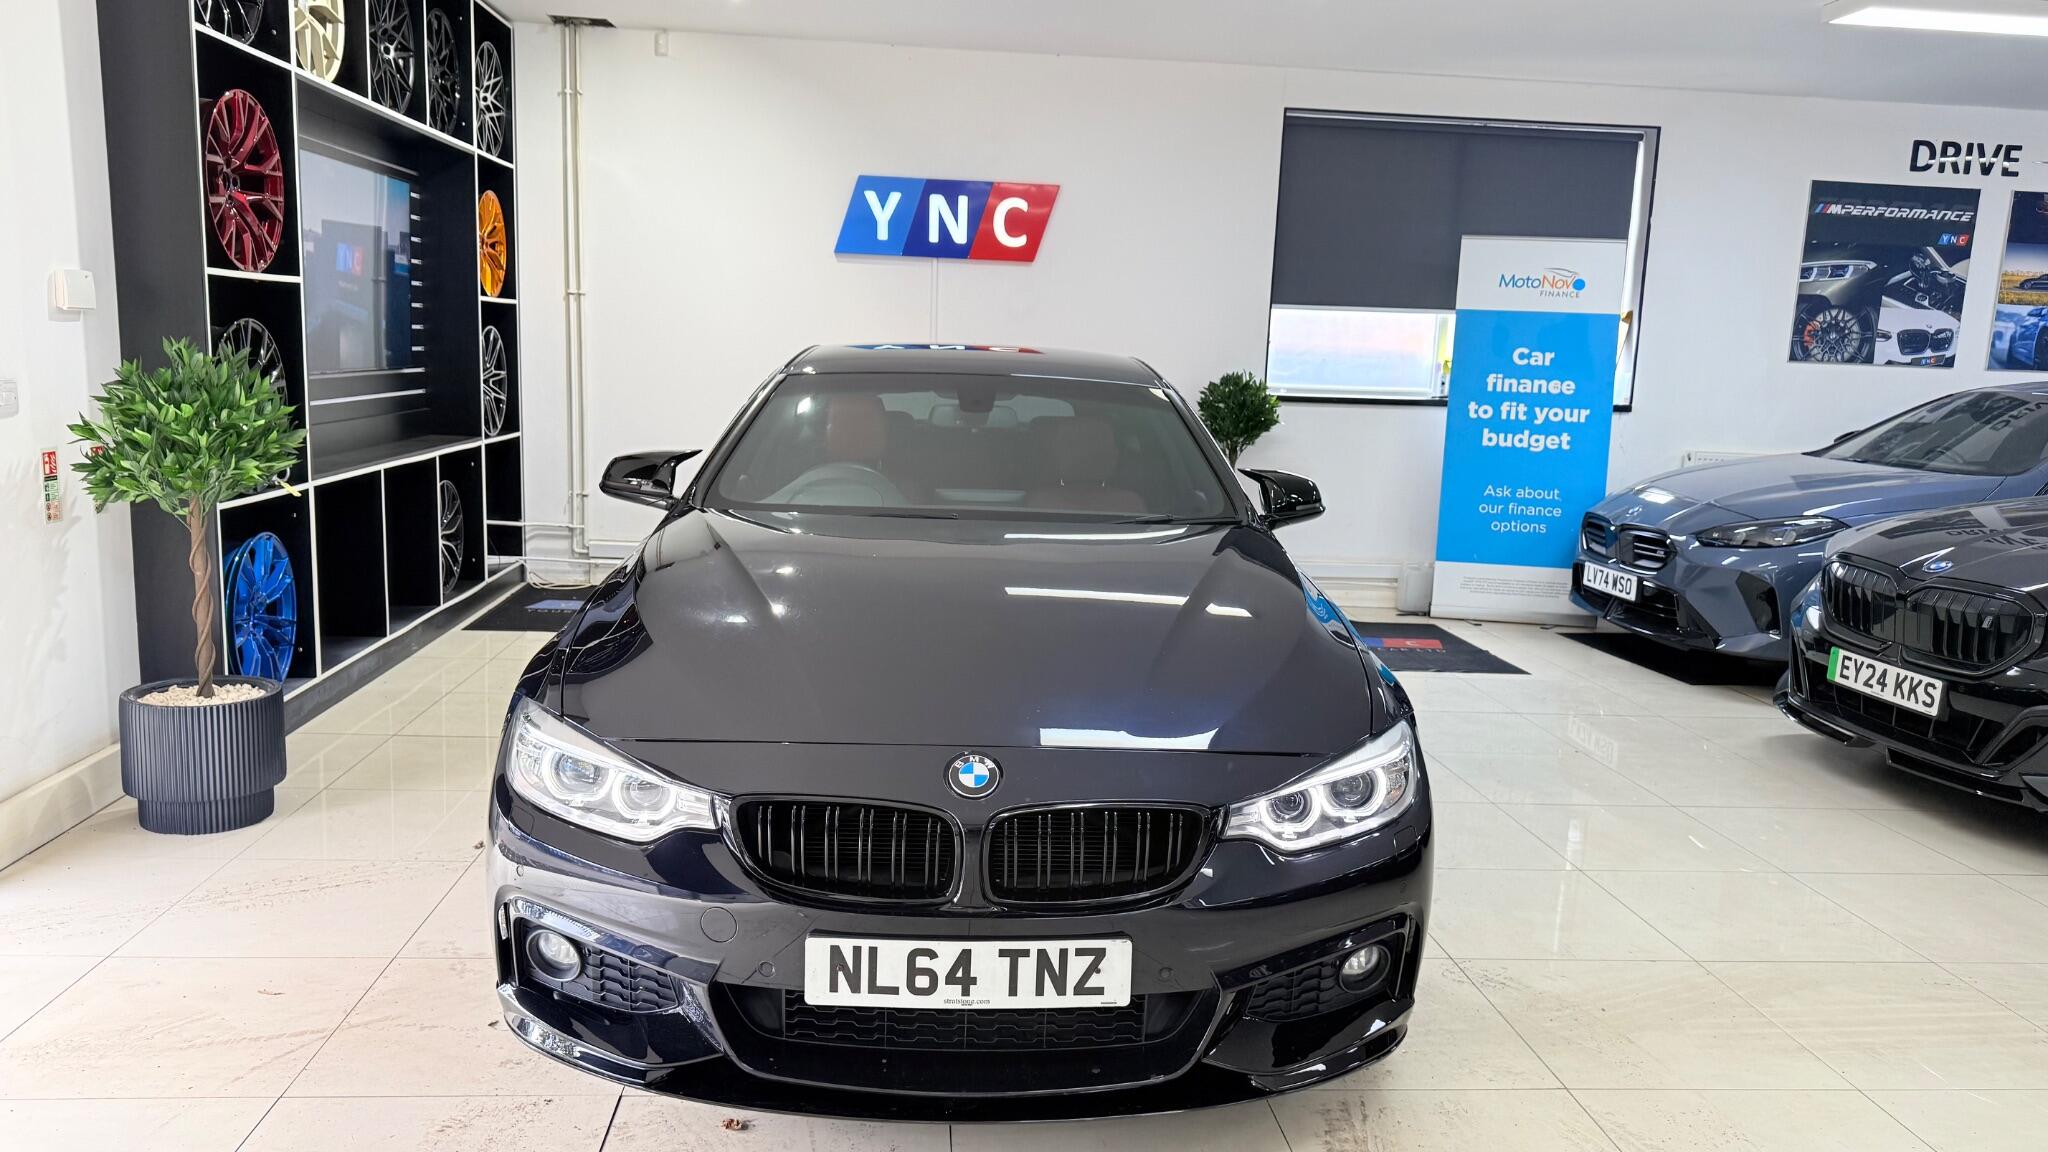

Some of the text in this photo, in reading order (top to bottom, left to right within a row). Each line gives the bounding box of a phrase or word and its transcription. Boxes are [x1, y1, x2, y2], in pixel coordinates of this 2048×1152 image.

[1909, 139, 2023, 177] DRIVE
[863, 190, 1029, 248] YNC
[1941, 234, 1966, 244] YNC
[1512, 347, 1555, 366] Car
[1486, 374, 1576, 395] finance
[1468, 401, 1590, 425] to fit your
[1482, 428, 1571, 452] budget
[1484, 485, 1560, 500] Ask about
[1479, 503, 1562, 517] our finance
[1491, 520, 1547, 534] options
[1586, 565, 1609, 588] LV74
[1611, 571, 1632, 596] WSO
[1839, 655, 1937, 709] EY24 KKS
[829, 944, 1107, 998] NL64 TNZ
